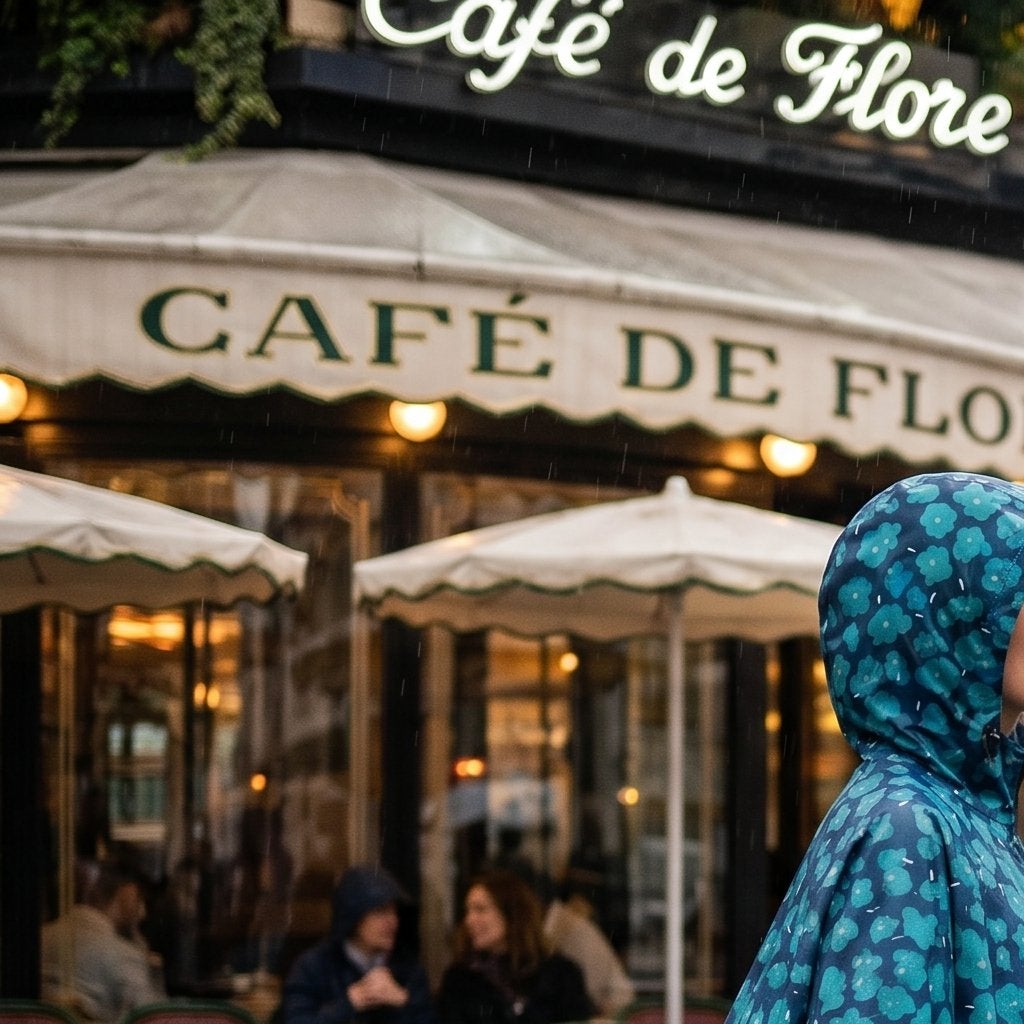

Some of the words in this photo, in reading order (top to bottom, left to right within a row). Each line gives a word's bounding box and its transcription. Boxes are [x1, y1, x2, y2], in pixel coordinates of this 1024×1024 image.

[646, 15, 748, 104] de
[775, 22, 1013, 155] Flore
[138, 286, 554, 379] CAFÉ
[620, 326, 780, 405] DE
